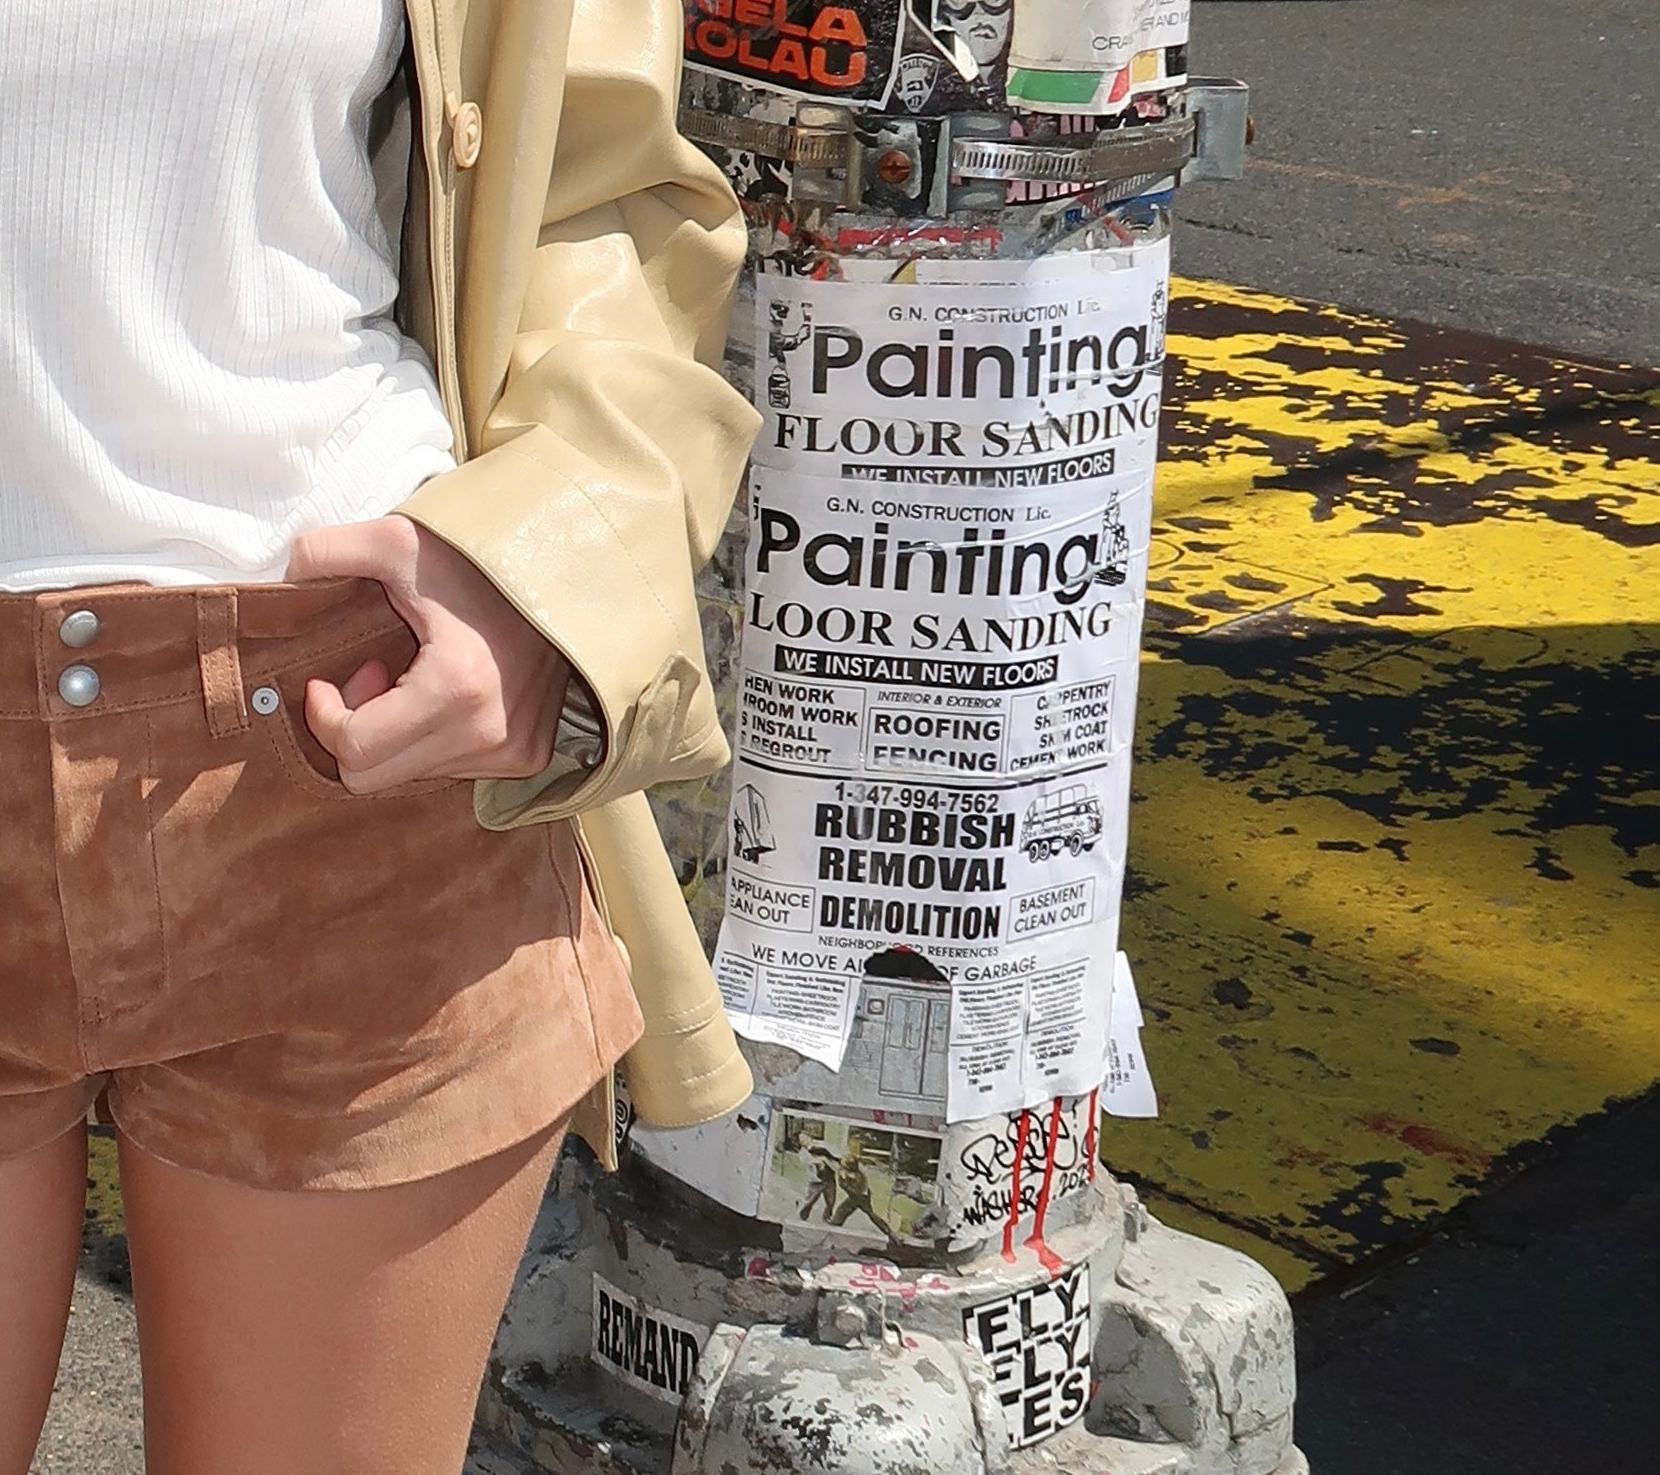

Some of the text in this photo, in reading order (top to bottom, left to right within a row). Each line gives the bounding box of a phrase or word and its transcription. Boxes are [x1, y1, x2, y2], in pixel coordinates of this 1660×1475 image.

[935, 303, 1068, 323] CONSTRUCTION
[812, 324, 1148, 398] Painting
[774, 392, 1160, 458] FLOOR SANDING
[1046, 454, 1112, 484] FLOORS
[826, 497, 864, 515] G.N.
[872, 500, 1014, 522] CONSTRUCTION
[756, 507, 1098, 605] Painting
[910, 602, 1112, 654] SANDING
[783, 649, 1055, 686] WE INSTALL NEW FLOORS
[778, 683, 835, 704] WORK
[877, 690, 930, 705] INTERIOR
[946, 696, 1002, 709] EXTERIOR
[752, 715, 818, 742] INSTALL
[801, 706, 859, 727] WORK
[874, 714, 1001, 741] ROOFING
[1075, 720, 1108, 738] COAT
[1066, 740, 1106, 759] WORK
[835, 782, 999, 813] 1-347-994-7562
[815, 803, 1016, 849] RUBBISH
[818, 846, 1007, 892] REMOVAL
[731, 876, 1086, 913] APPLIANCE BASEMENT
[760, 906, 790, 924] OUT
[820, 895, 1002, 940] DEMOLITION
[1015, 902, 1087, 933] CLEAN OUT
[752, 943, 776, 963] WE
[781, 951, 838, 972] MOVE
[964, 956, 1037, 981] GARBAGE
[928, 946, 999, 958] REFERENCES
[598, 1289, 699, 1397] REMAND
